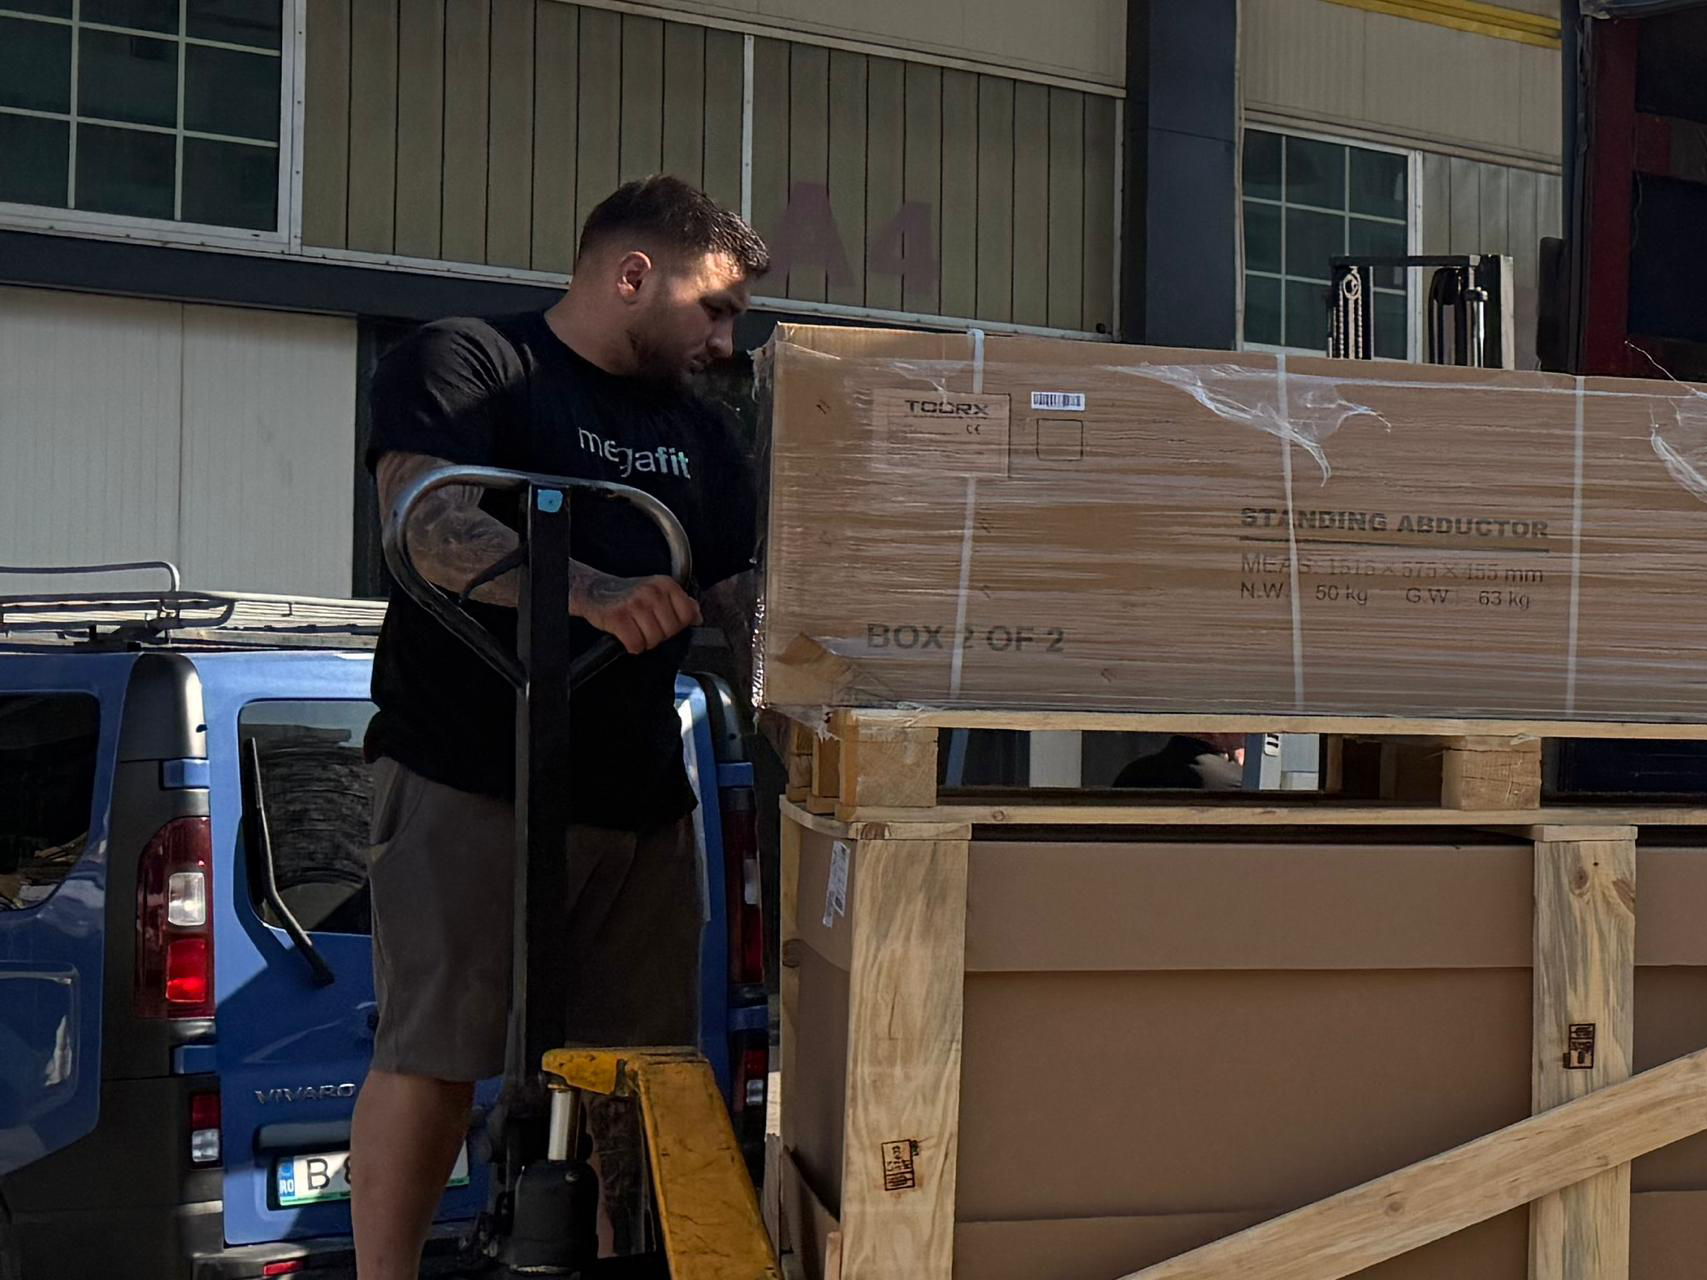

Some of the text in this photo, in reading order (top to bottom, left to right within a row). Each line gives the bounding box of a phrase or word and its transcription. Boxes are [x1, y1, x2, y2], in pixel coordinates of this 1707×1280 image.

[768, 181, 937, 295] A4
[578, 427, 691, 480] megafit
[1240, 507, 1549, 538] STANDING ABDUCTOR
[1504, 568, 1544, 583] mm
[1315, 584, 1340, 601] 50
[1346, 584, 1368, 606] kg
[1478, 590, 1502, 607] 63
[1508, 591, 1530, 611] kg
[866, 623, 944, 650] BOX
[987, 625, 1034, 652] OF
[1045, 626, 1065, 653] 2
[255, 1083, 356, 1105] VIVARO
[279, 1179, 294, 1194] RO
